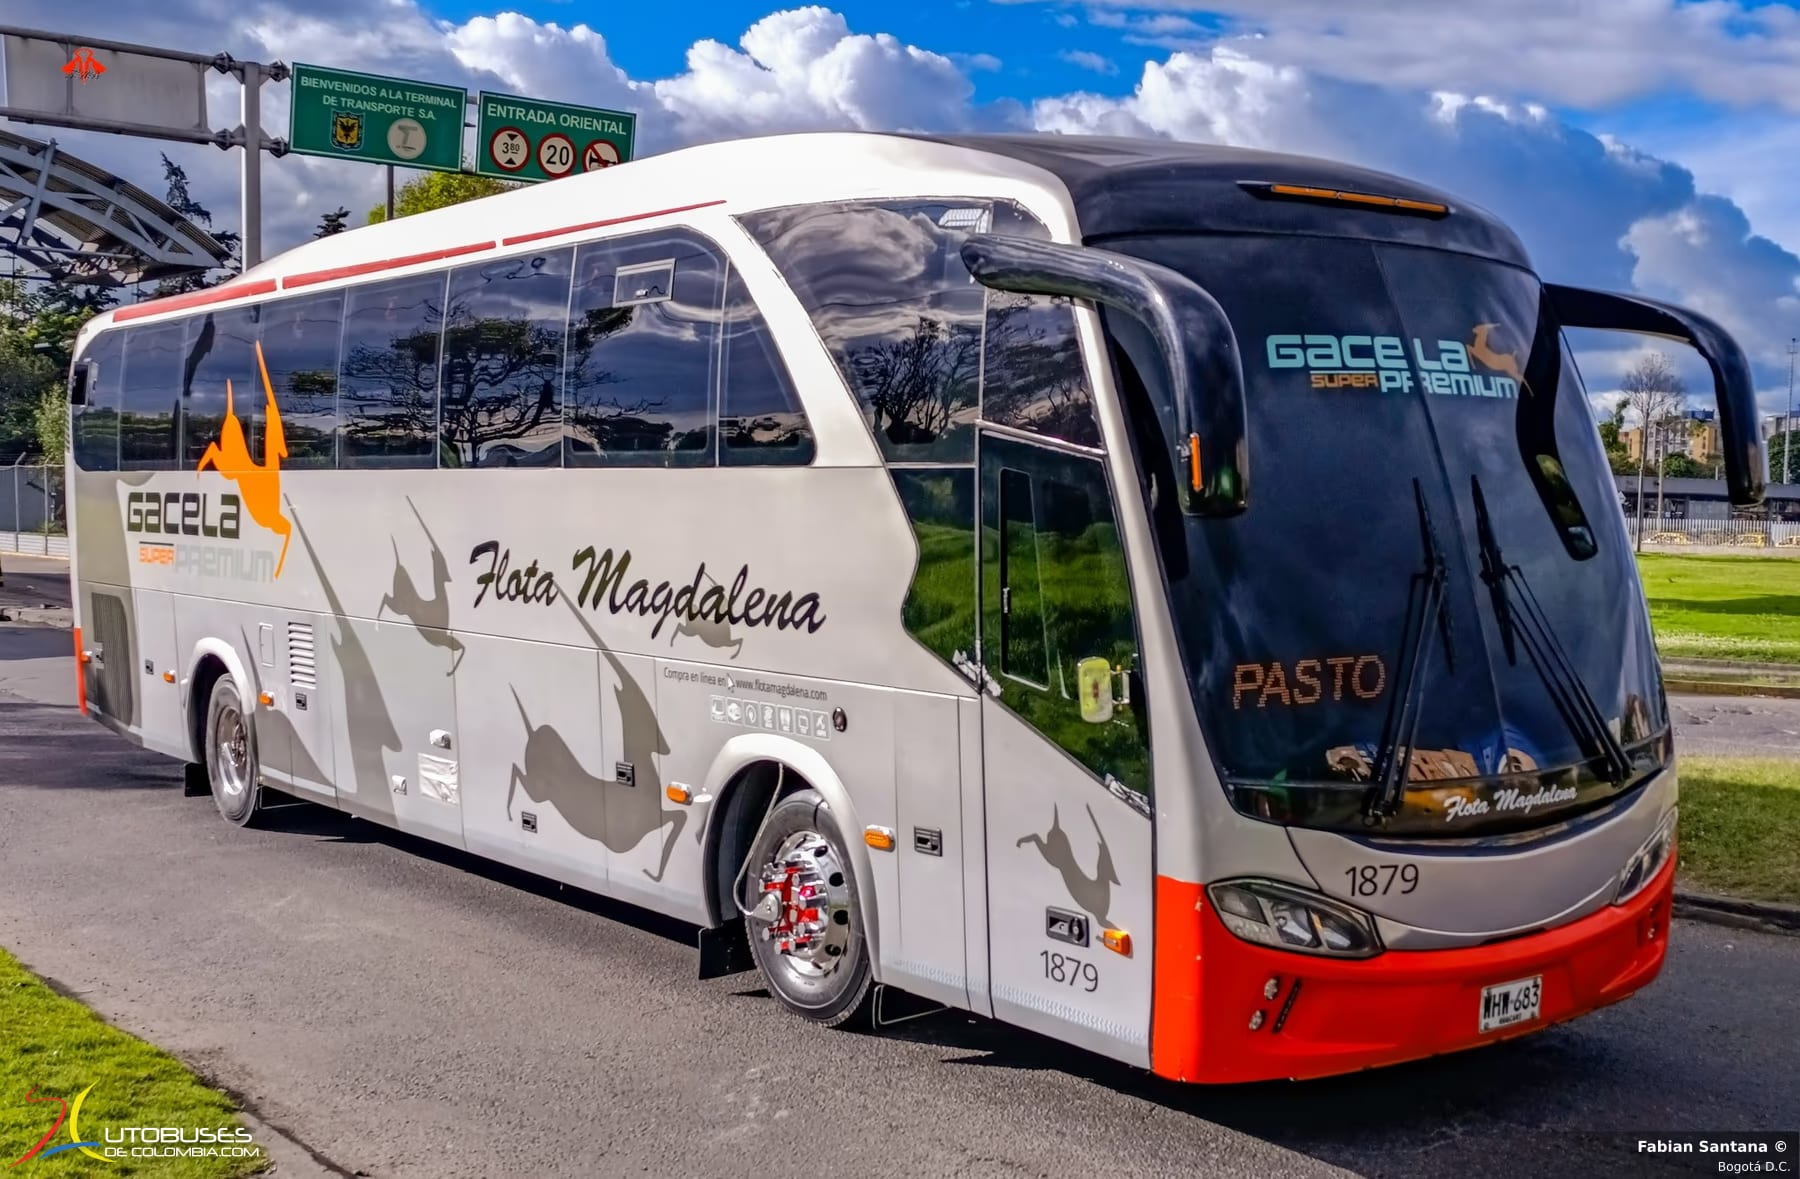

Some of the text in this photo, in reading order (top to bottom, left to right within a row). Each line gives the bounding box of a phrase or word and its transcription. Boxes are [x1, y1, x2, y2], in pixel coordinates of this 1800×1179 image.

[300, 76, 457, 109] BIENVENIDOS A LA TERMINAL
[322, 95, 338, 106] DE
[340, 97, 415, 118] TRANSPORTE
[487, 103, 627, 135] ENTRADA ORIENTAL
[546, 144, 570, 166] 20
[1310, 374, 1379, 388] SUPER
[139, 547, 174, 565] SUPER
[469, 540, 826, 640] Flota Magdalena
[663, 667, 690, 682] Compra
[690, 671, 699, 682] en
[717, 676, 727, 687] en
[735, 678, 828, 701] www.flotamagdalena.com
[1233, 654, 1386, 710] PASTO
[1443, 783, 1578, 822] Flota Magdalena
[1344, 863, 1419, 897] 1879
[1040, 950, 1099, 992] 1879
